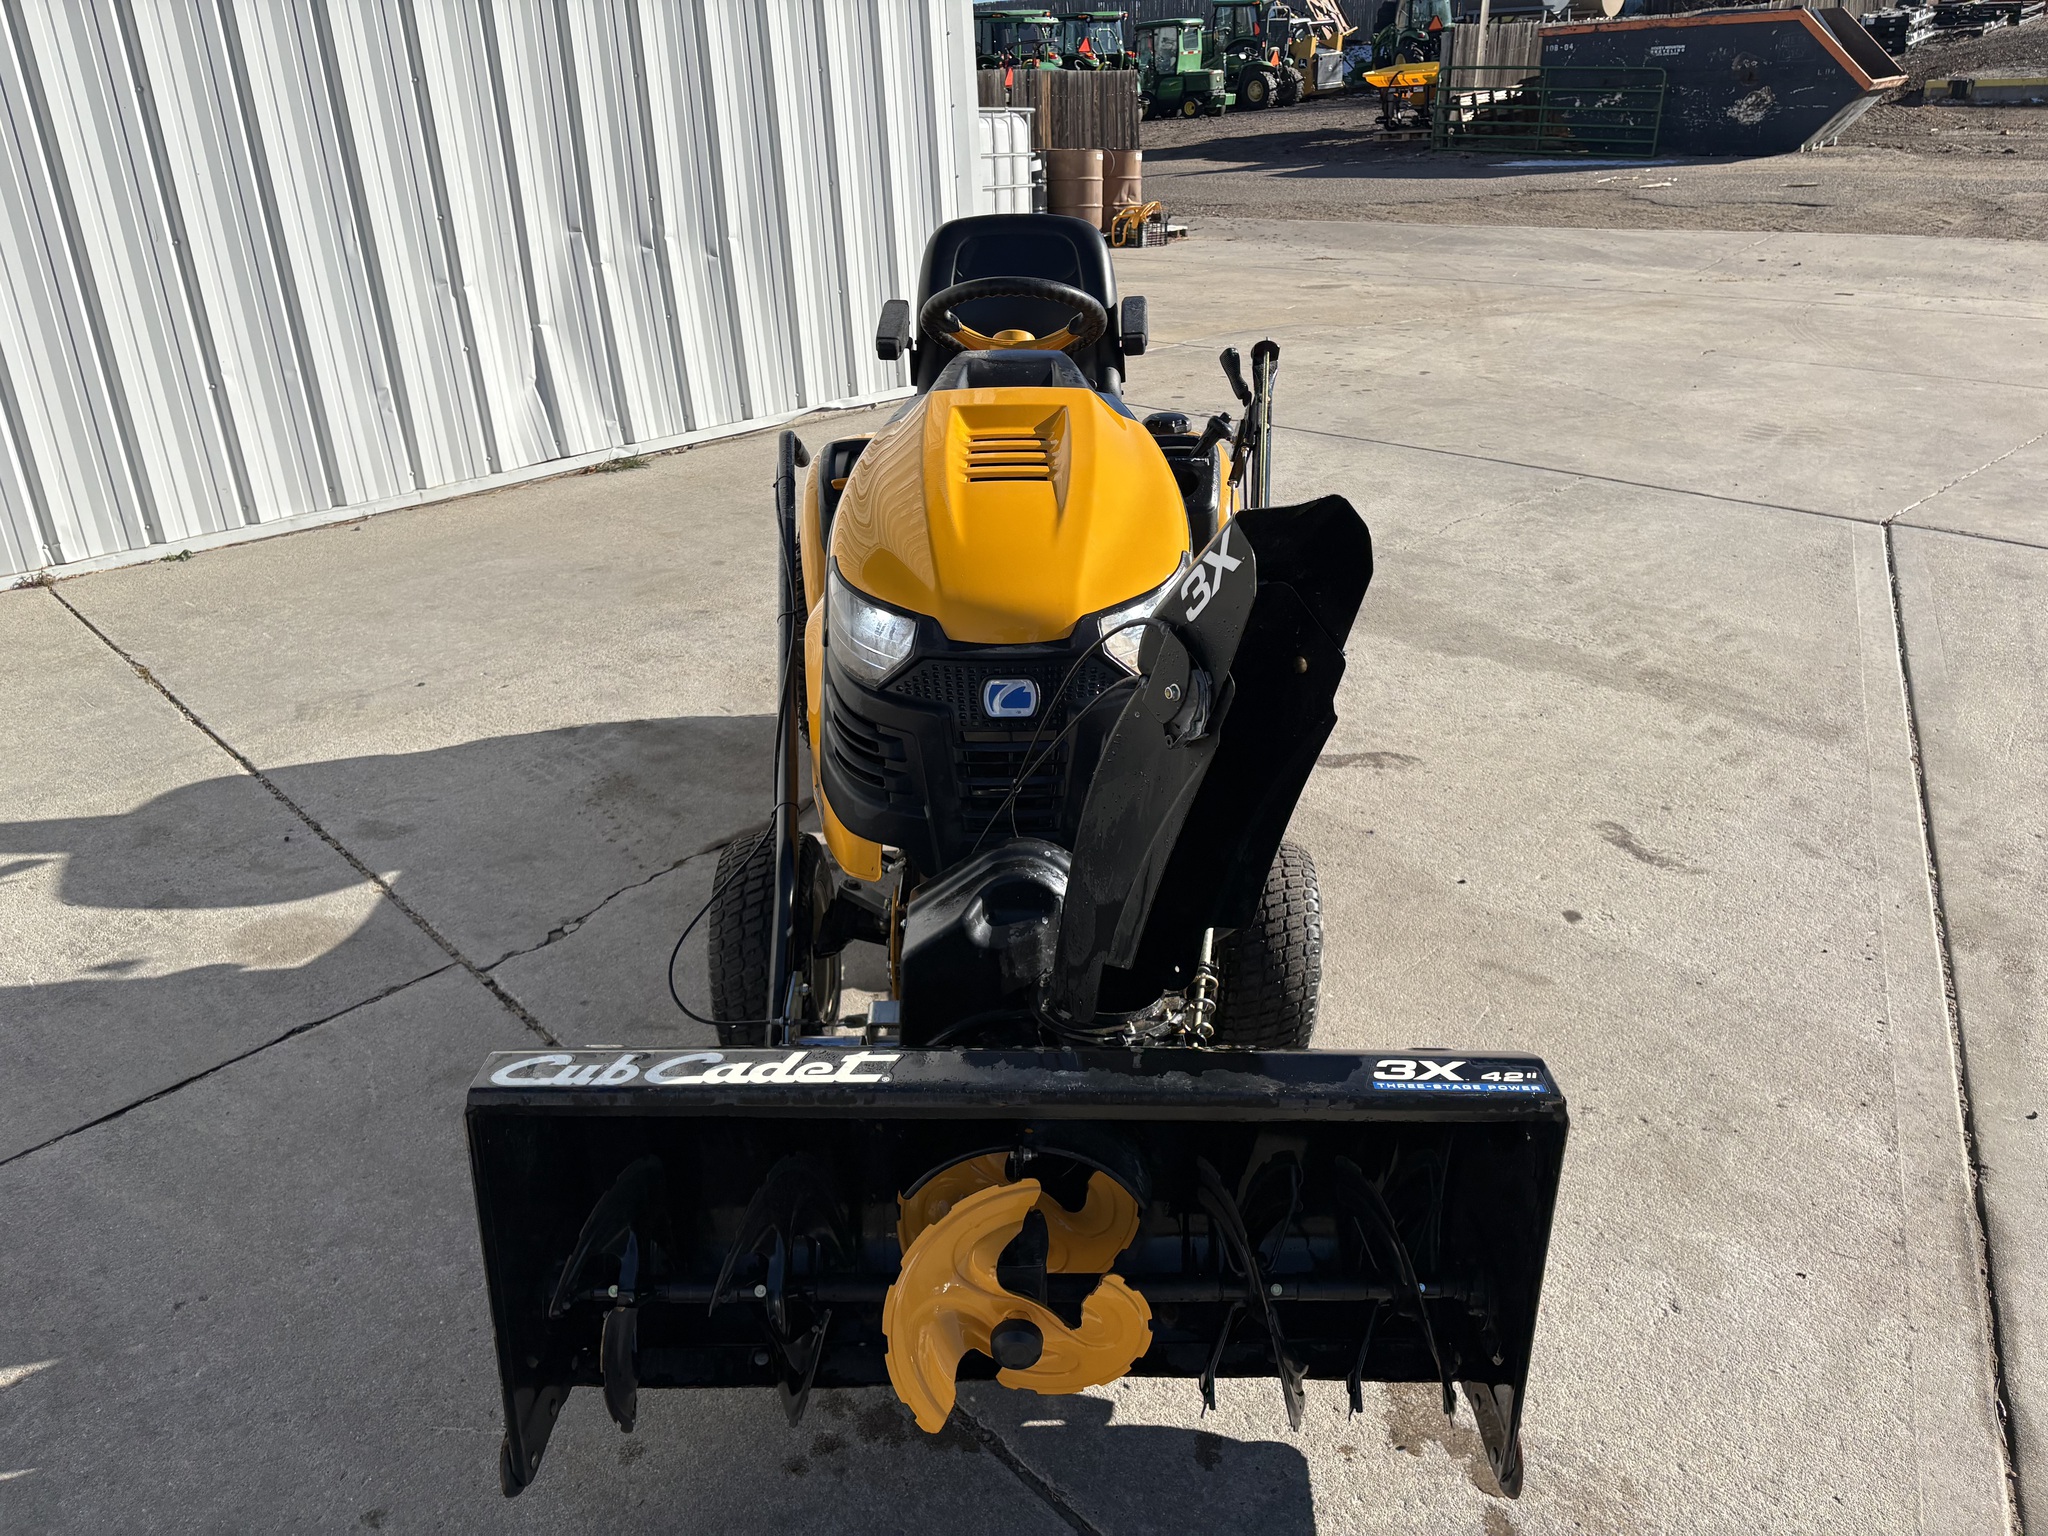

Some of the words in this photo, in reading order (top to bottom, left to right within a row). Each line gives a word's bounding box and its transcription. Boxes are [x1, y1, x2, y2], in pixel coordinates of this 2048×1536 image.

[1180, 524, 1242, 622] 3X
[490, 1054, 640, 1086] Cub
[644, 1051, 901, 1084] Cadet
[1373, 1059, 1467, 1081] 3X
[1480, 1071, 1538, 1082] 42"
[1376, 1082, 1482, 1090] THREE-STAGE
